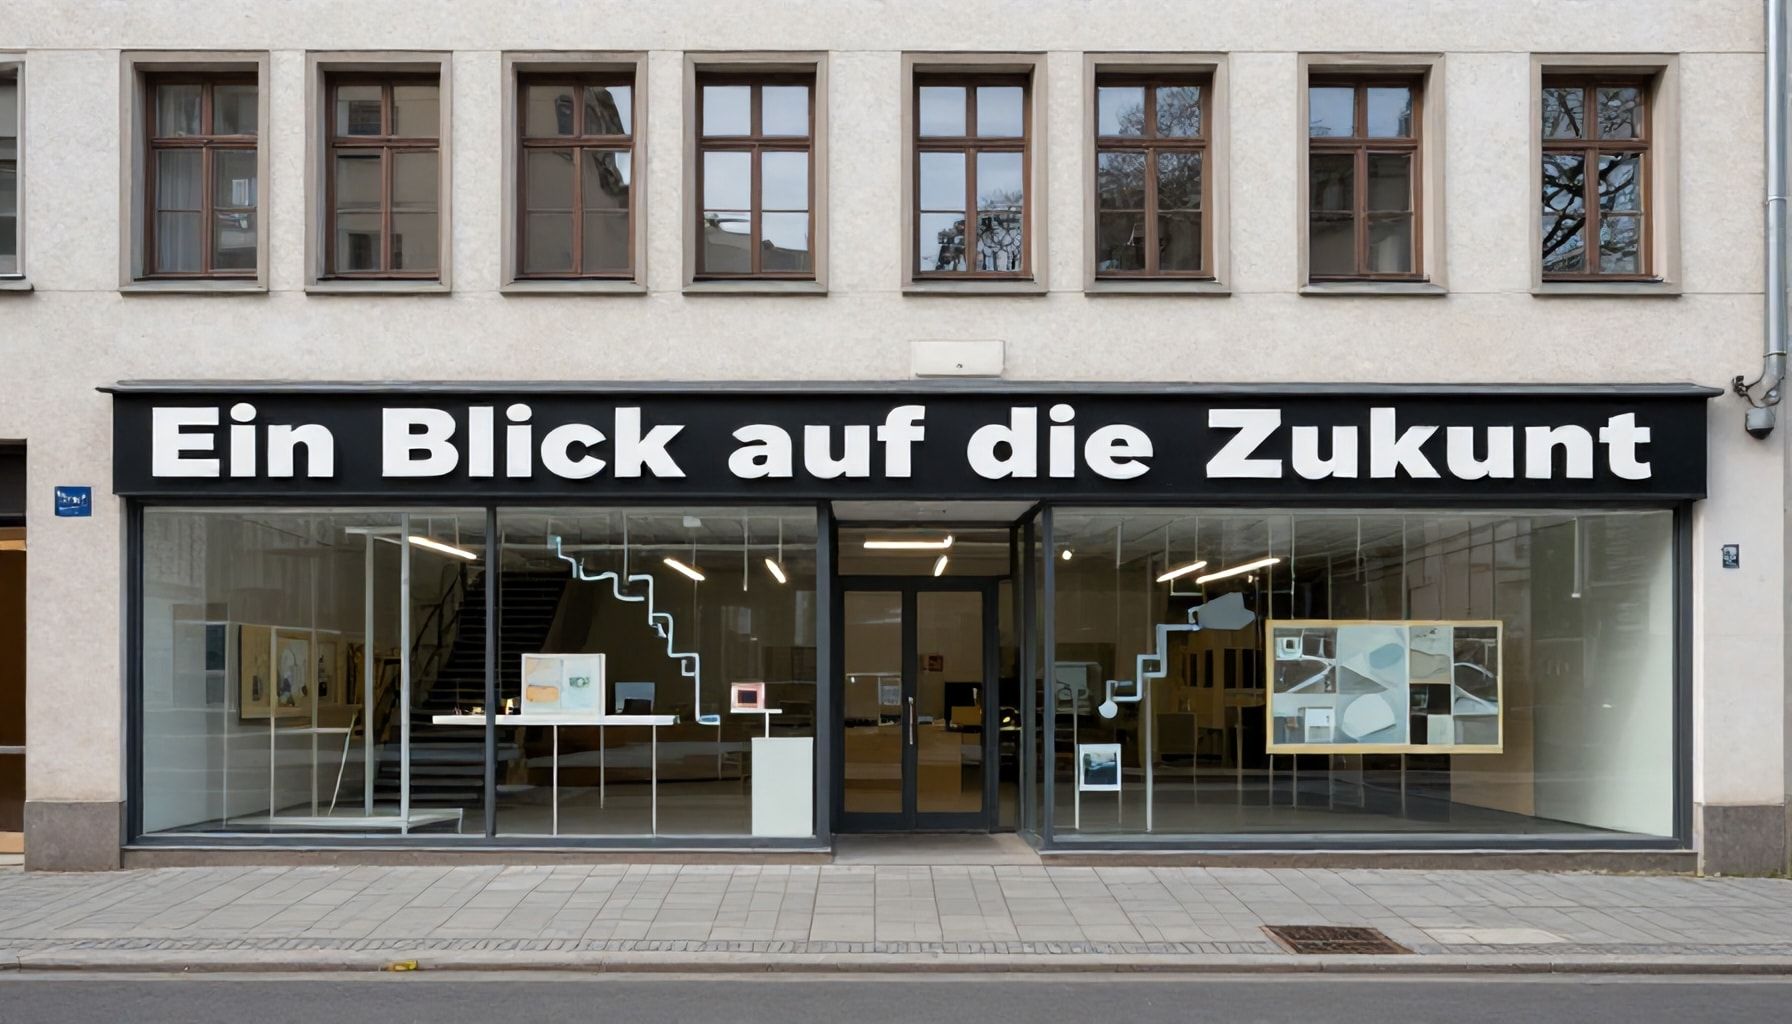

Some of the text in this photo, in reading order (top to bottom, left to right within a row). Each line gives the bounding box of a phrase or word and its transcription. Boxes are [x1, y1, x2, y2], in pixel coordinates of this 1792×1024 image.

[152, 403, 1652, 480] Ein Blick auf die Zukunt
